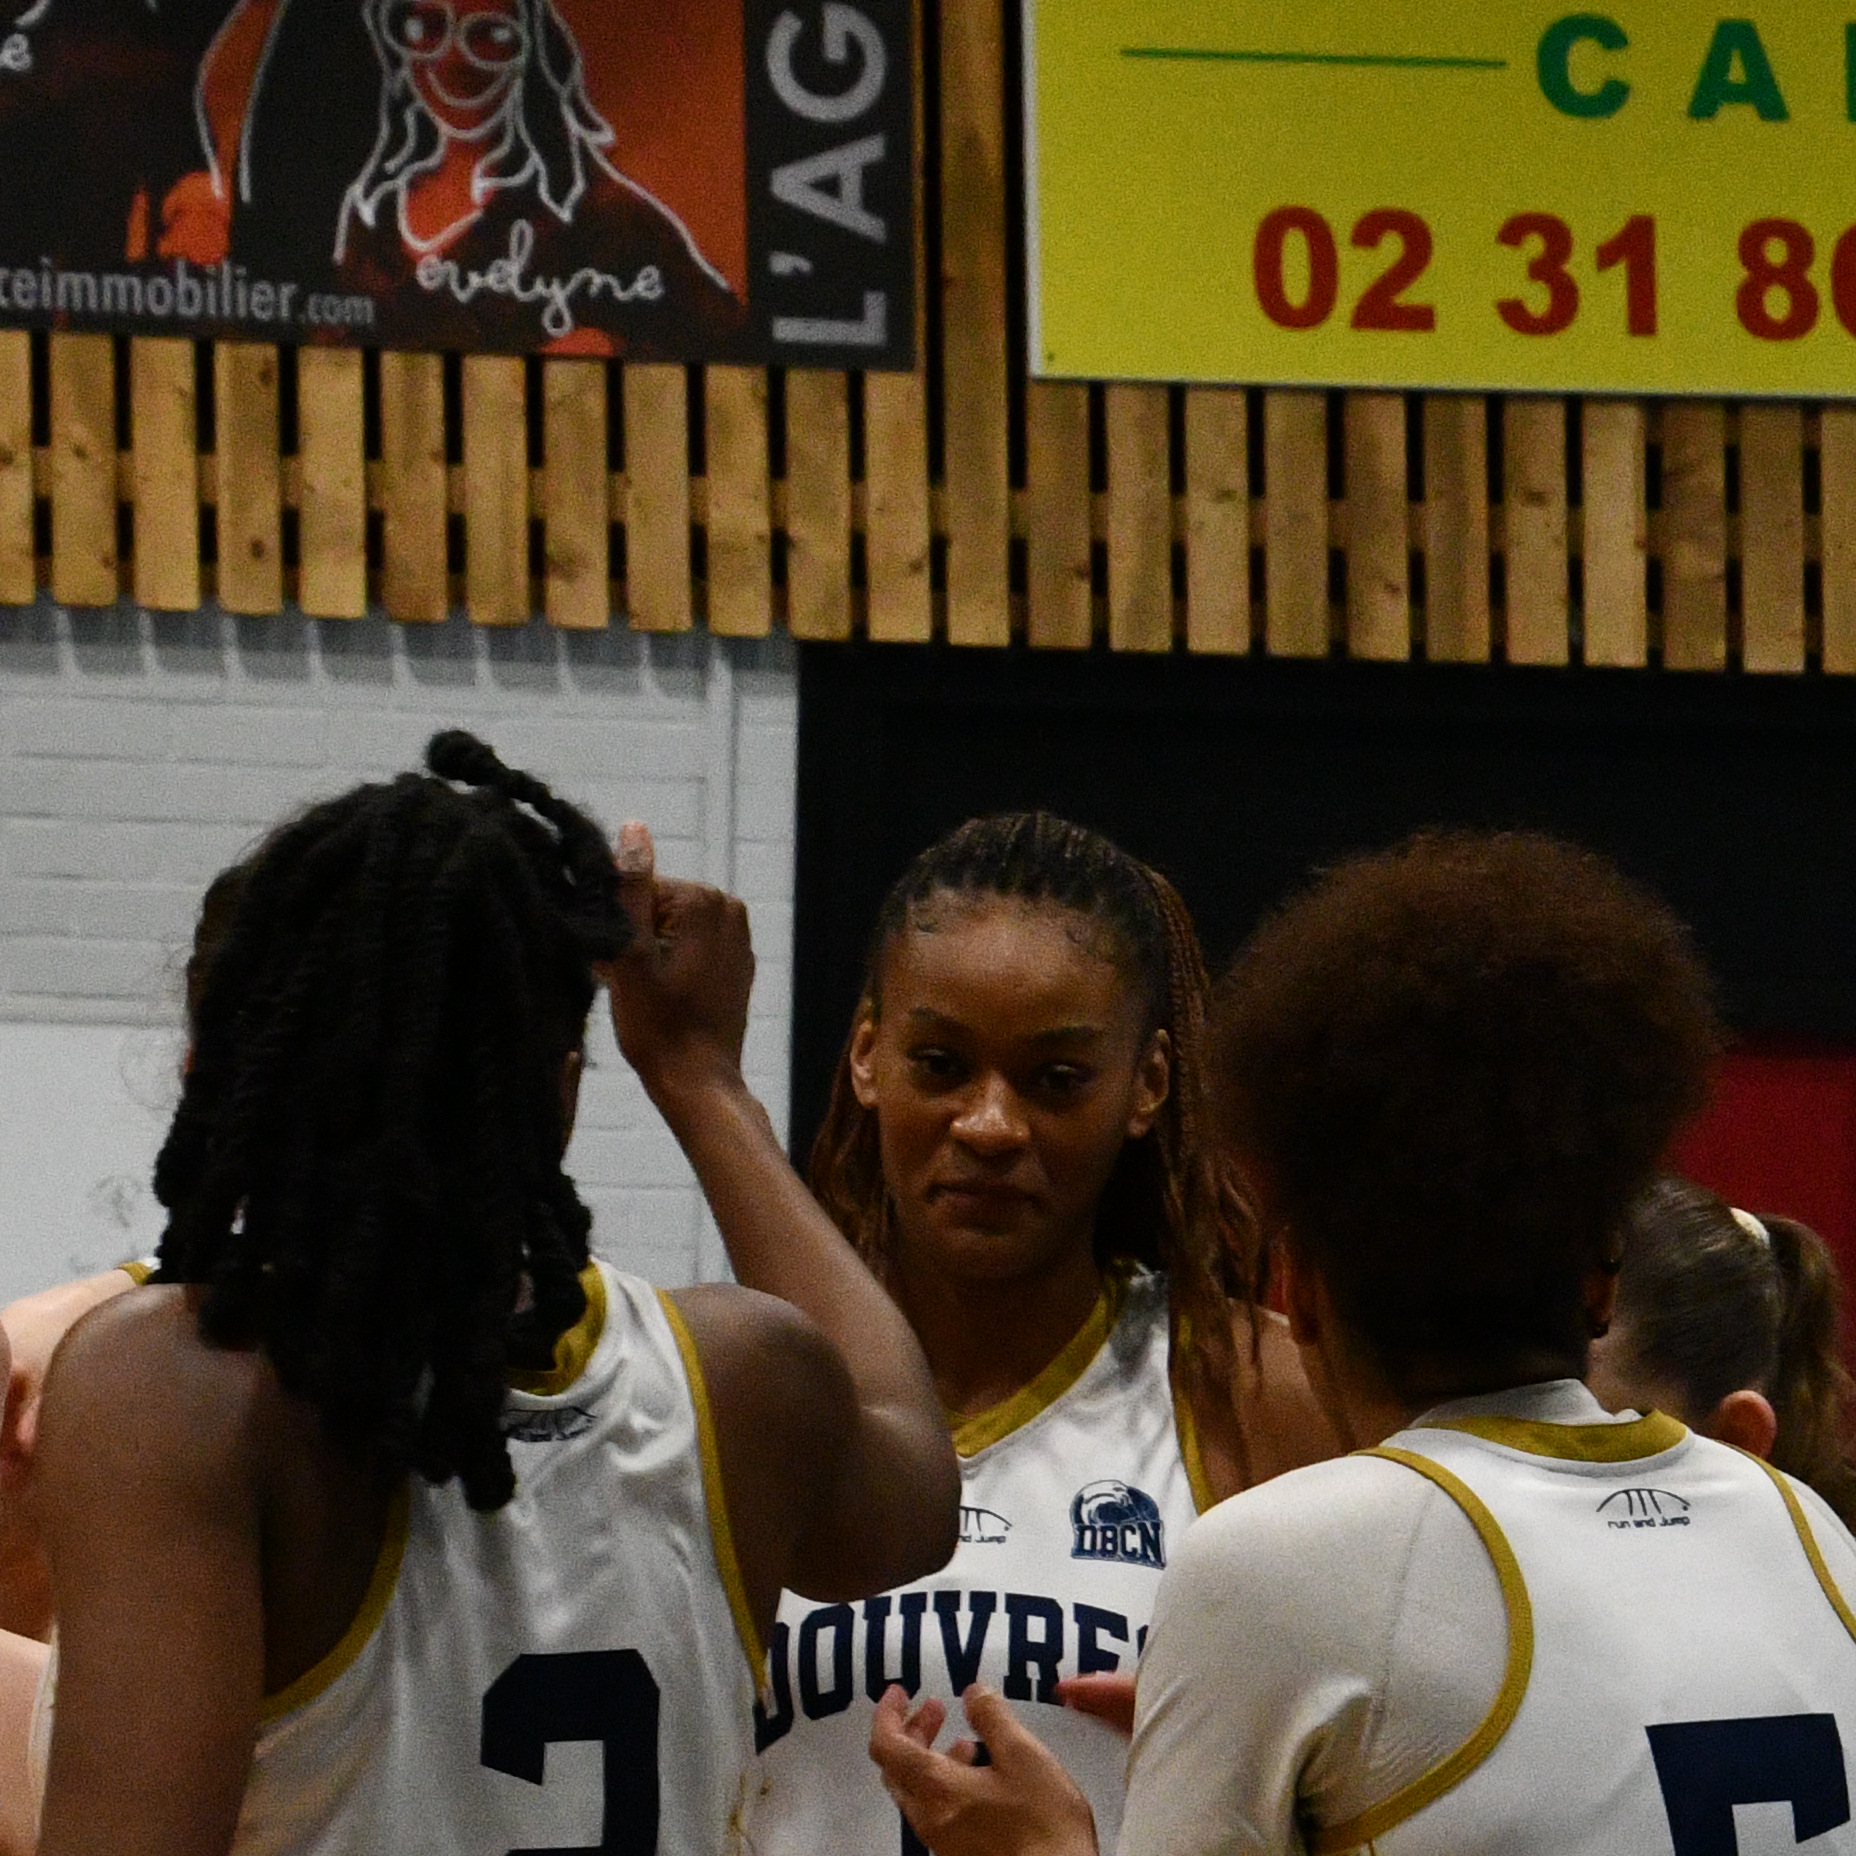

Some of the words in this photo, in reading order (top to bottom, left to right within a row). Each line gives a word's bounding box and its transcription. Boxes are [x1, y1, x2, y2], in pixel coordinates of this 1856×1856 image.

[1252, 205, 1437, 333] 02
[1494, 213, 1661, 338] 31
[1076, 1520, 1166, 1568] DBCN
[752, 1589, 1150, 1756] DOUVRE
